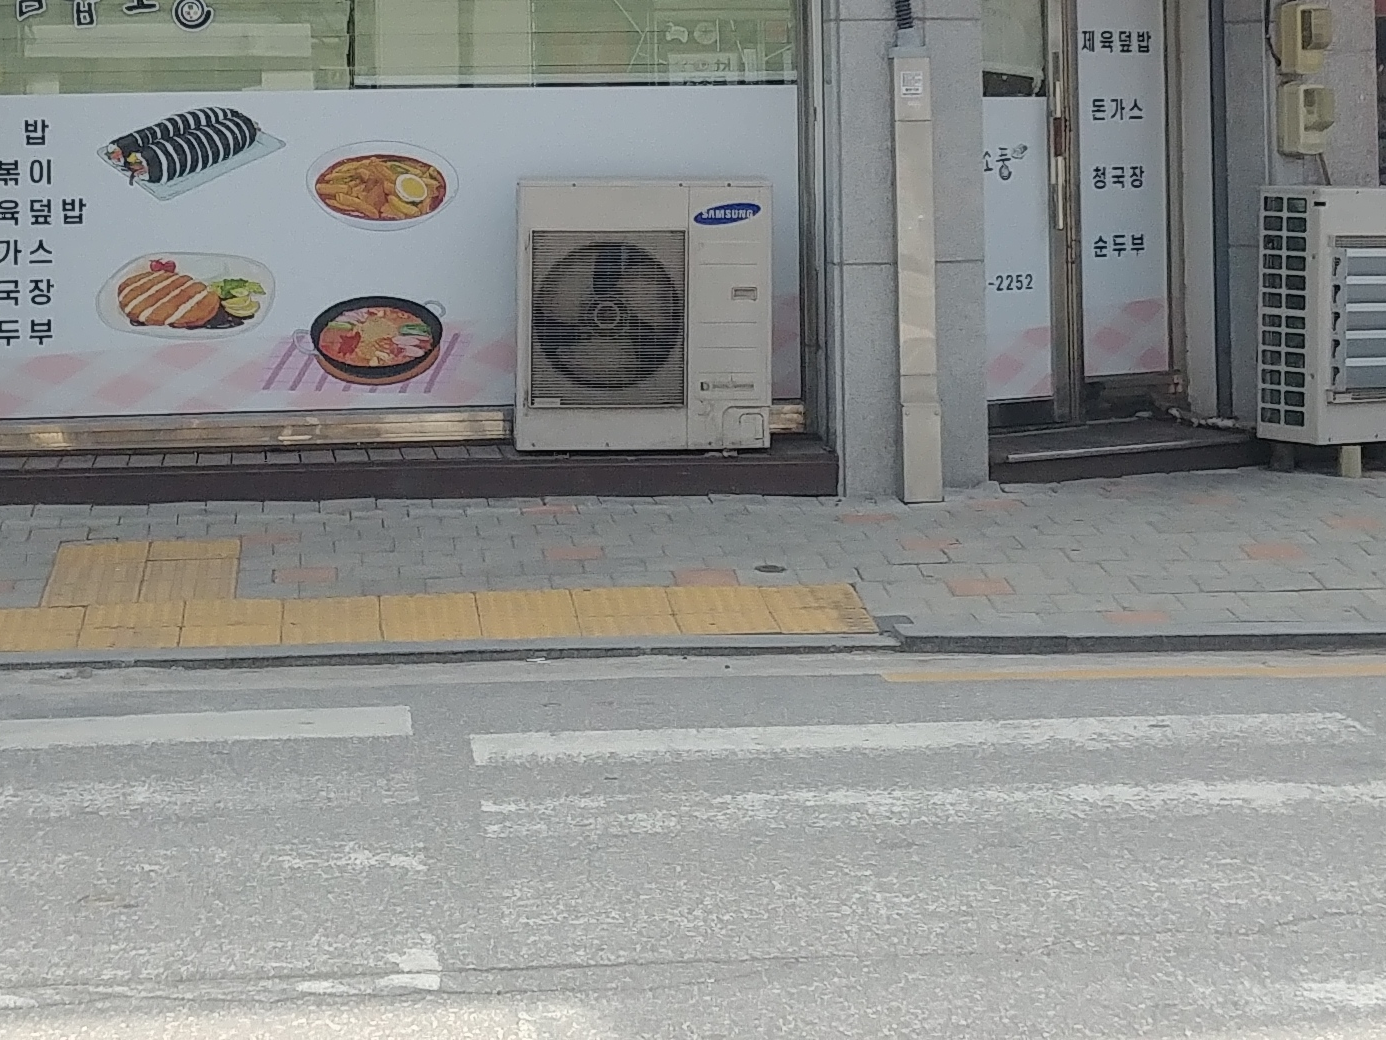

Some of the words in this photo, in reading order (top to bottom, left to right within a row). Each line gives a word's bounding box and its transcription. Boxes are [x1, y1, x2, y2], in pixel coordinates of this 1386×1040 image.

[1081, 30, 1152, 53] 제육덮밥
[1091, 98, 1144, 121] 돈가스
[1092, 166, 1144, 189] 청국장
[701, 208, 754, 219] SAMSUNG
[1093, 234, 1145, 257] 순두부
